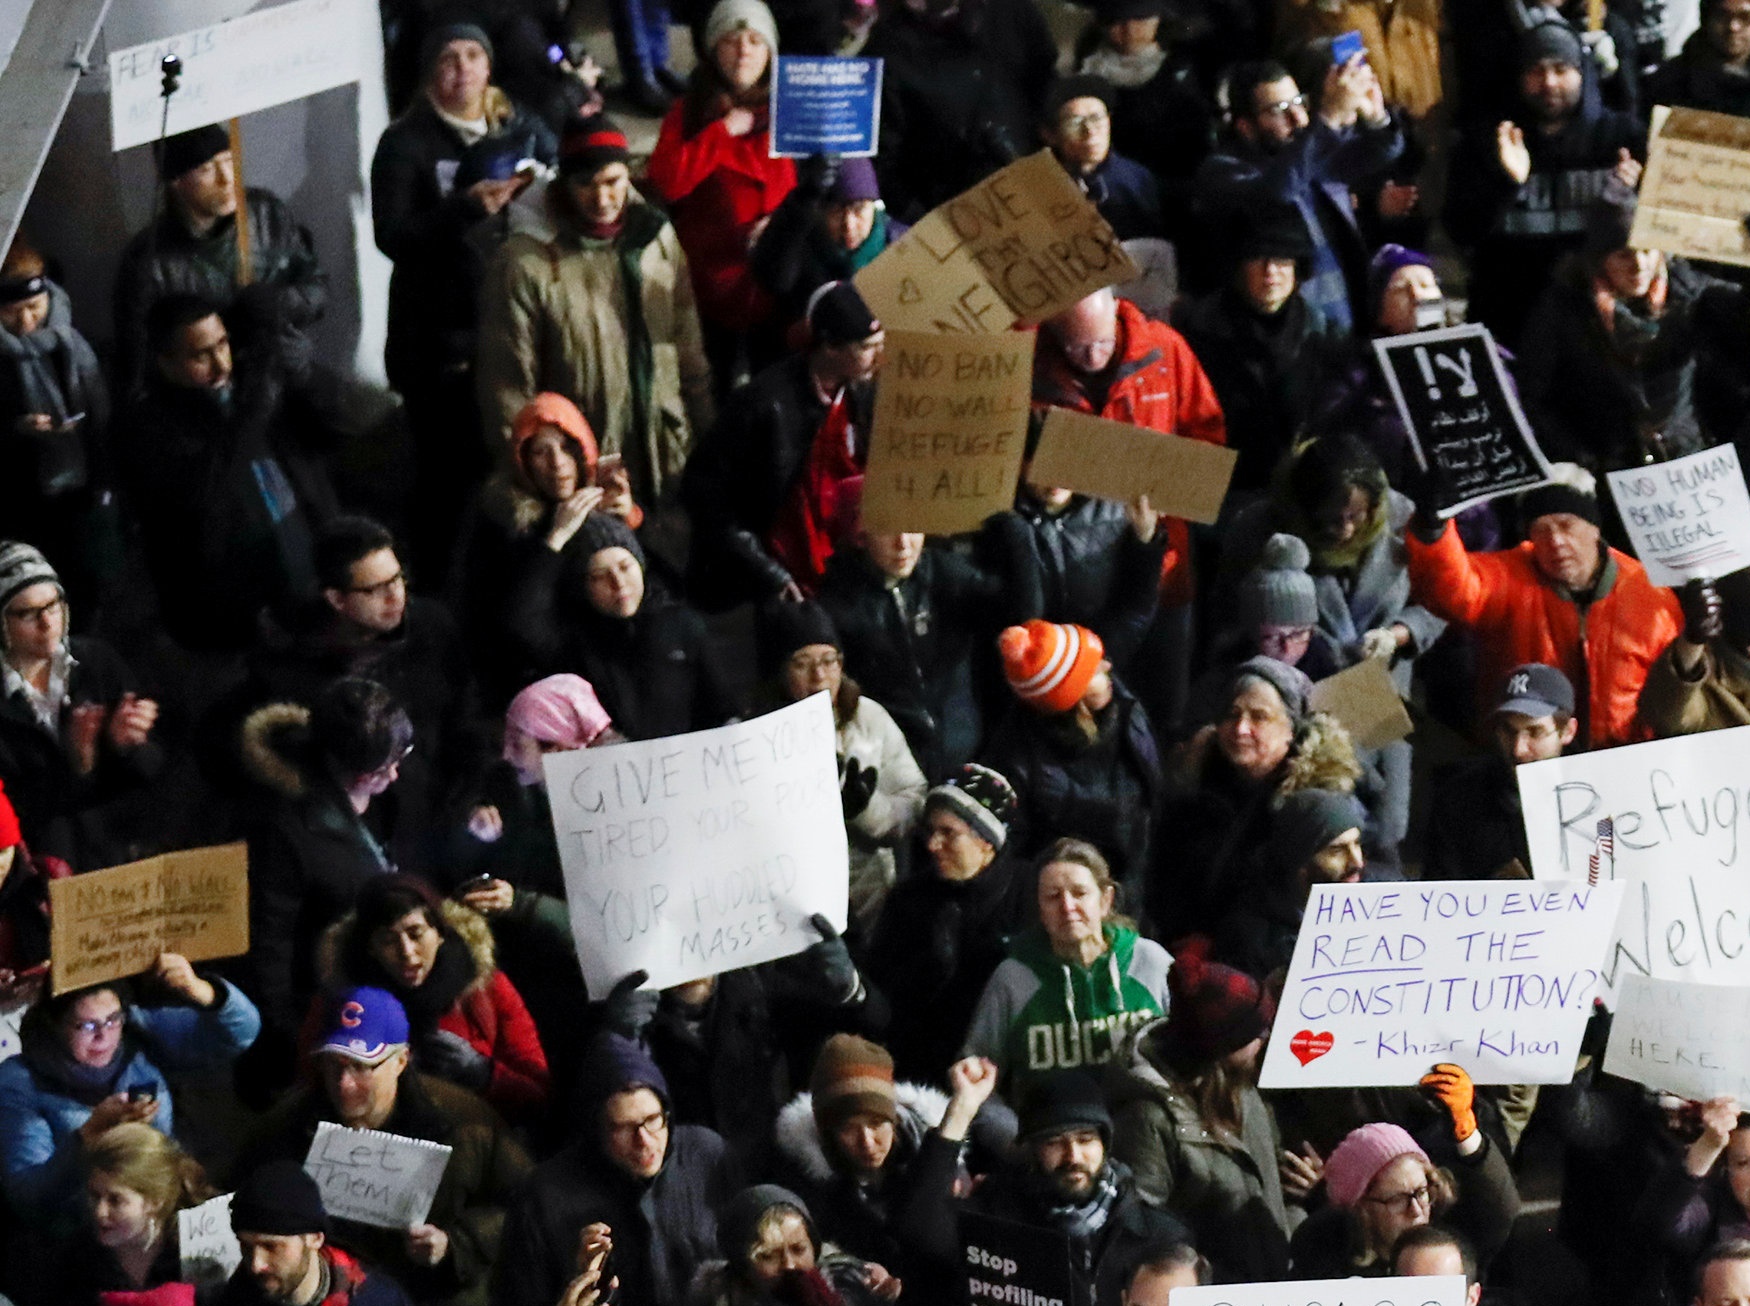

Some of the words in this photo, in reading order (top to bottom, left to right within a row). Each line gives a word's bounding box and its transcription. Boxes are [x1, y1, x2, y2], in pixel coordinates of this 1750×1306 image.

[911, 173, 1031, 265] LOVE
[897, 350, 944, 380] NO
[953, 351, 1020, 382] BAN
[895, 393, 934, 420] NO
[1618, 478, 1659, 499] NO
[1669, 454, 1737, 496] HUMAN
[1630, 499, 1686, 529] BEING
[1694, 489, 1726, 516] IS
[1644, 522, 1725, 554] ILLEGAL
[570, 750, 686, 813] GIVE
[700, 737, 758, 790] ME
[569, 816, 671, 871] TIRED
[694, 799, 756, 841] YOUR
[600, 883, 671, 943] YOUR
[690, 853, 798, 923] HUDDLED
[1314, 891, 1404, 928] HAVE
[1420, 890, 1490, 922] YOU
[1499, 887, 1594, 917] EVEN
[679, 911, 788, 967] MASSES
[1311, 932, 1428, 969] READ
[1455, 929, 1547, 964] THE
[340, 1000, 364, 1029] C
[1297, 967, 1599, 1022] CONSTITUTION?
[1475, 1024, 1561, 1058] Khan
[320, 1129, 404, 1173] Let
[188, 1210, 219, 1241] We
[966, 1245, 1018, 1278] Stop
